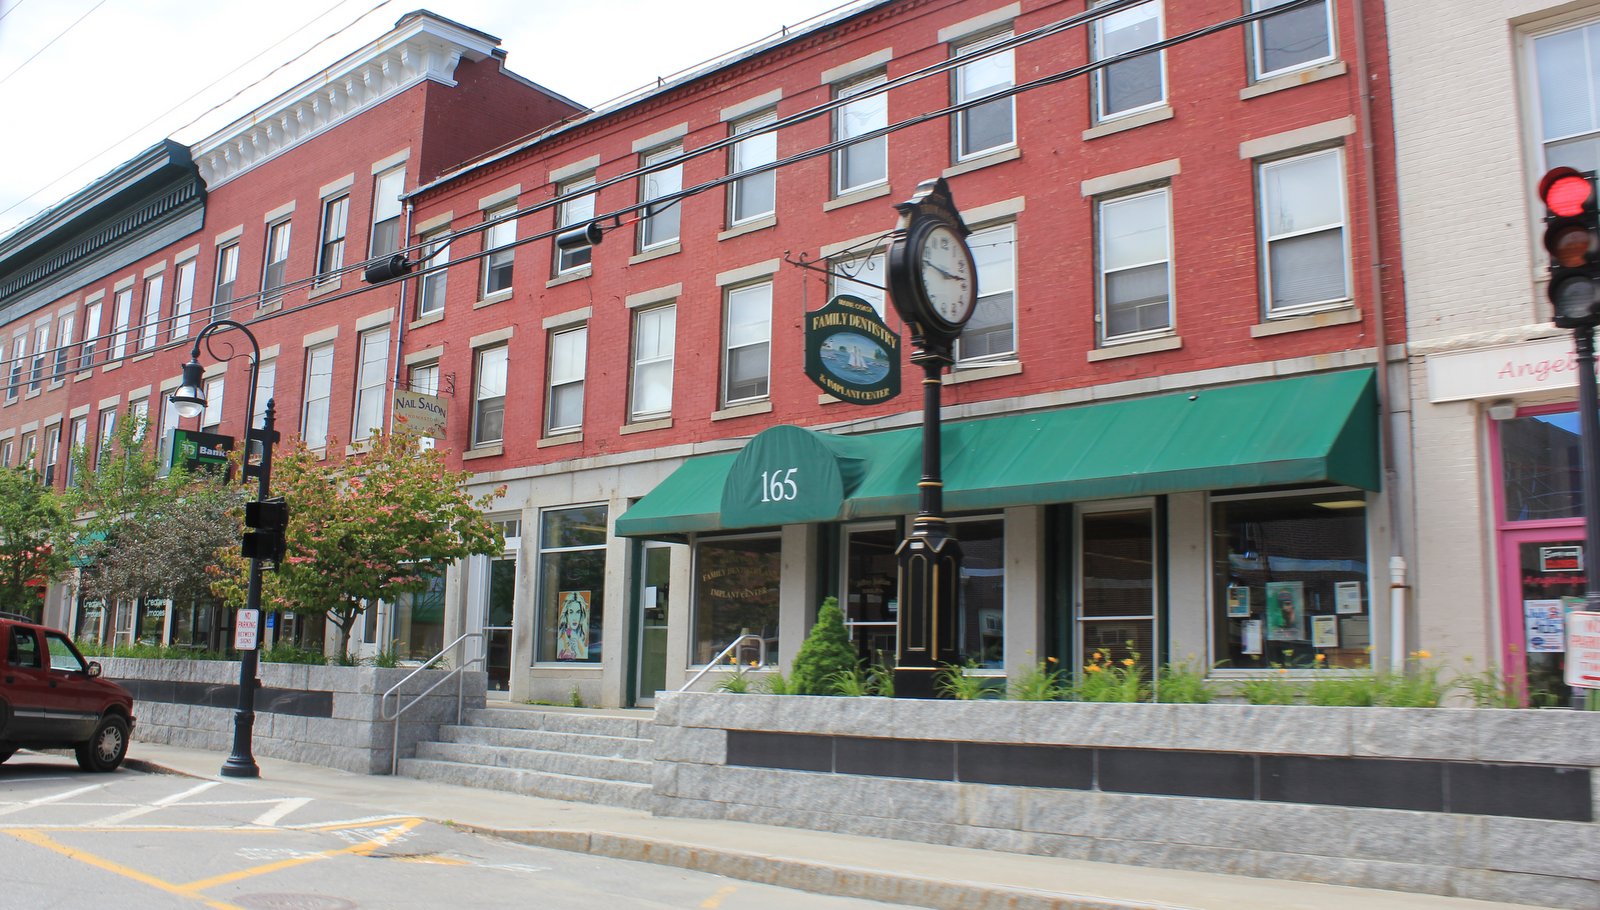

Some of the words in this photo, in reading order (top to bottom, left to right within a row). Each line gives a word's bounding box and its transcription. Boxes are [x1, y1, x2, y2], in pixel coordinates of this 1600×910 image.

[813, 312, 849, 330] FAMILY
[849, 314, 897, 348] DENTISTRY
[819, 373, 826, 385] &
[827, 378, 861, 399] IMPLANT
[861, 388, 890, 400] CENTER
[395, 397, 416, 410] NAIL
[418, 397, 447, 418] SALON
[199, 446, 226, 457] Bank
[761, 467, 798, 502] 165
[244, 612, 252, 620] NO
